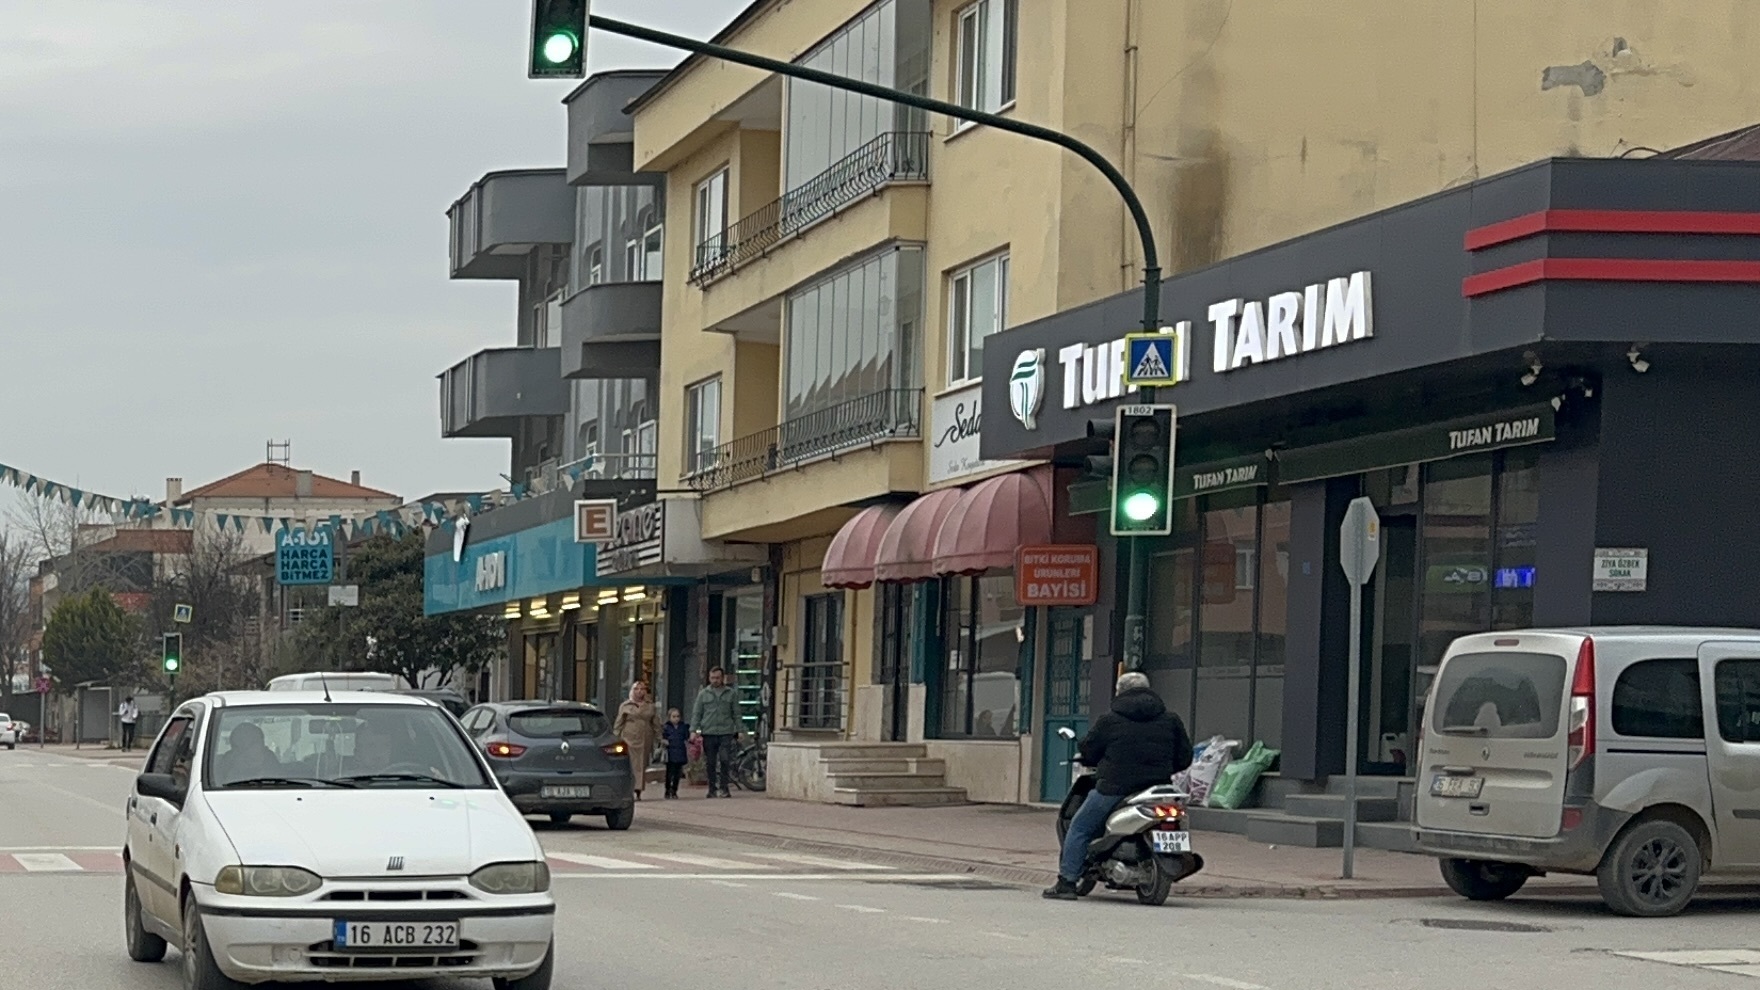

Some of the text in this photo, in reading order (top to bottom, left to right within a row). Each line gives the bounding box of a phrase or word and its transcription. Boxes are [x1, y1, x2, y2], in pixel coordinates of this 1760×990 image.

[1207, 271, 1374, 374] TARIM
[1127, 405, 1152, 415] 1802
[1448, 417, 1540, 450] TUFAN TARIM
[1193, 464, 1259, 490] TUFAN TARIM
[281, 549, 328, 560] HARCA
[281, 559, 328, 570] HARCA
[1027, 580, 1086, 598] BAYİSİ
[351, 925, 455, 944] 16 ACB 232
